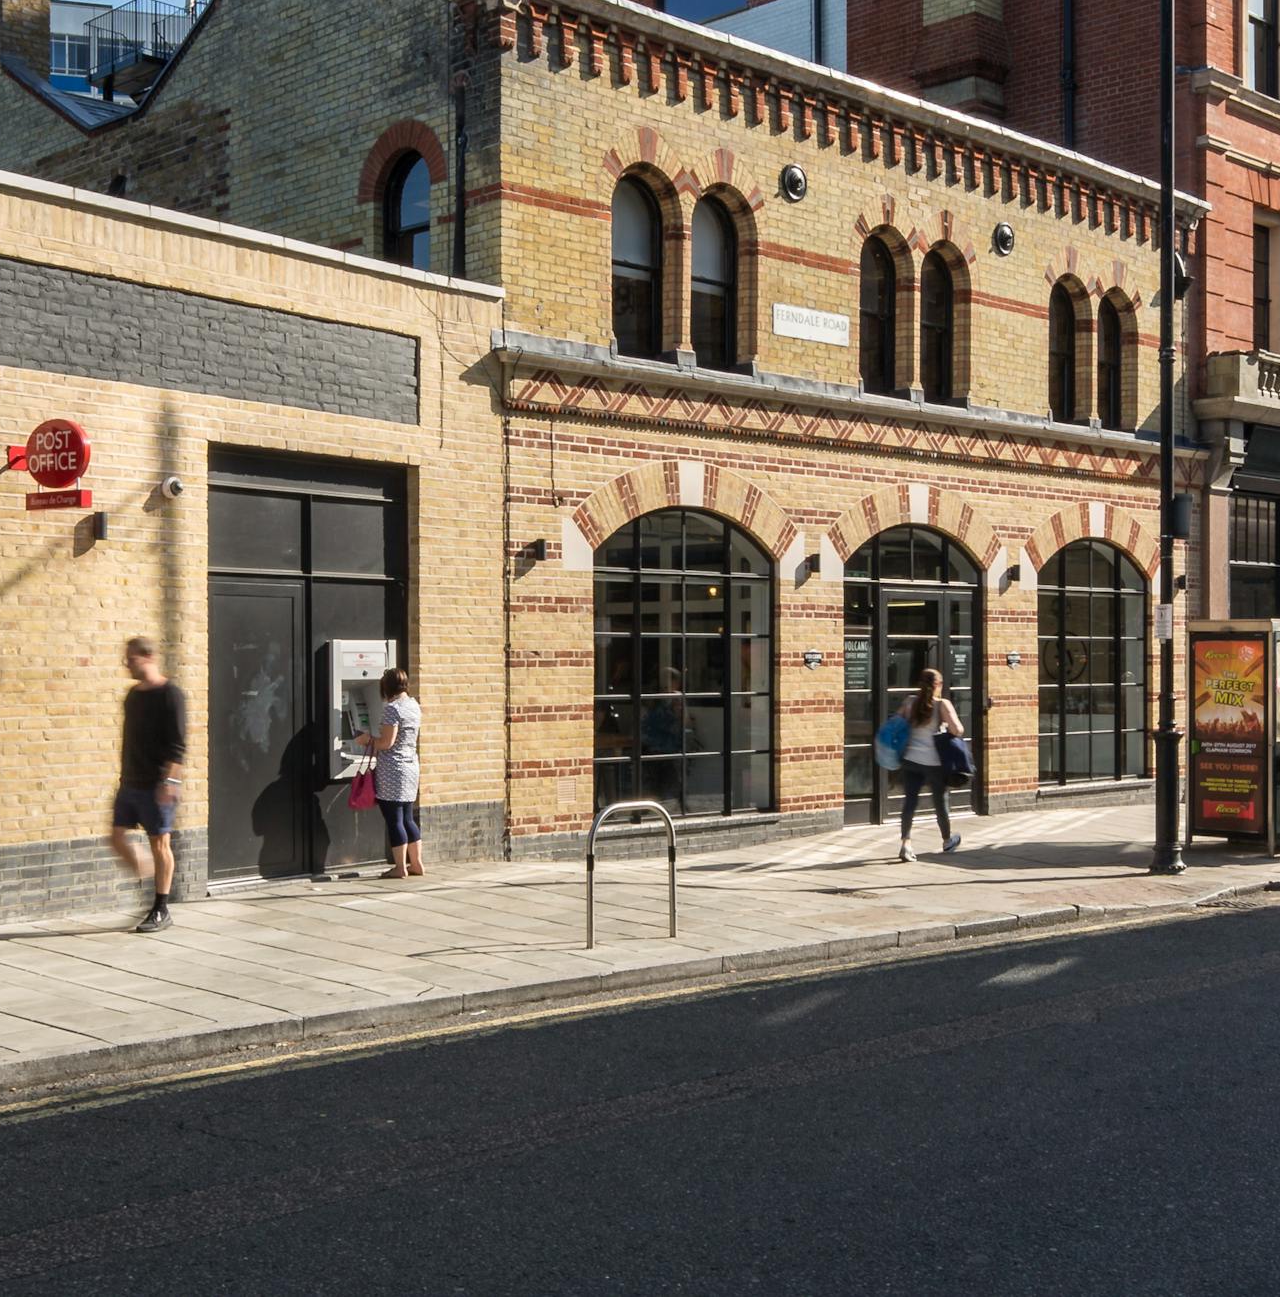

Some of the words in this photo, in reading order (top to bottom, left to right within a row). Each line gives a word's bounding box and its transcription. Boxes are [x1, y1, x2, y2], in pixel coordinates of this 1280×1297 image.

[776, 308, 821, 328] FERNDALE
[823, 317, 847, 332] ROAD
[36, 430, 72, 451] POST
[28, 451, 78, 474] OFFICE
[1205, 678, 1256, 693] PERFECT
[1215, 690, 1245, 707] MIX
[1215, 762, 1231, 771] YOU
